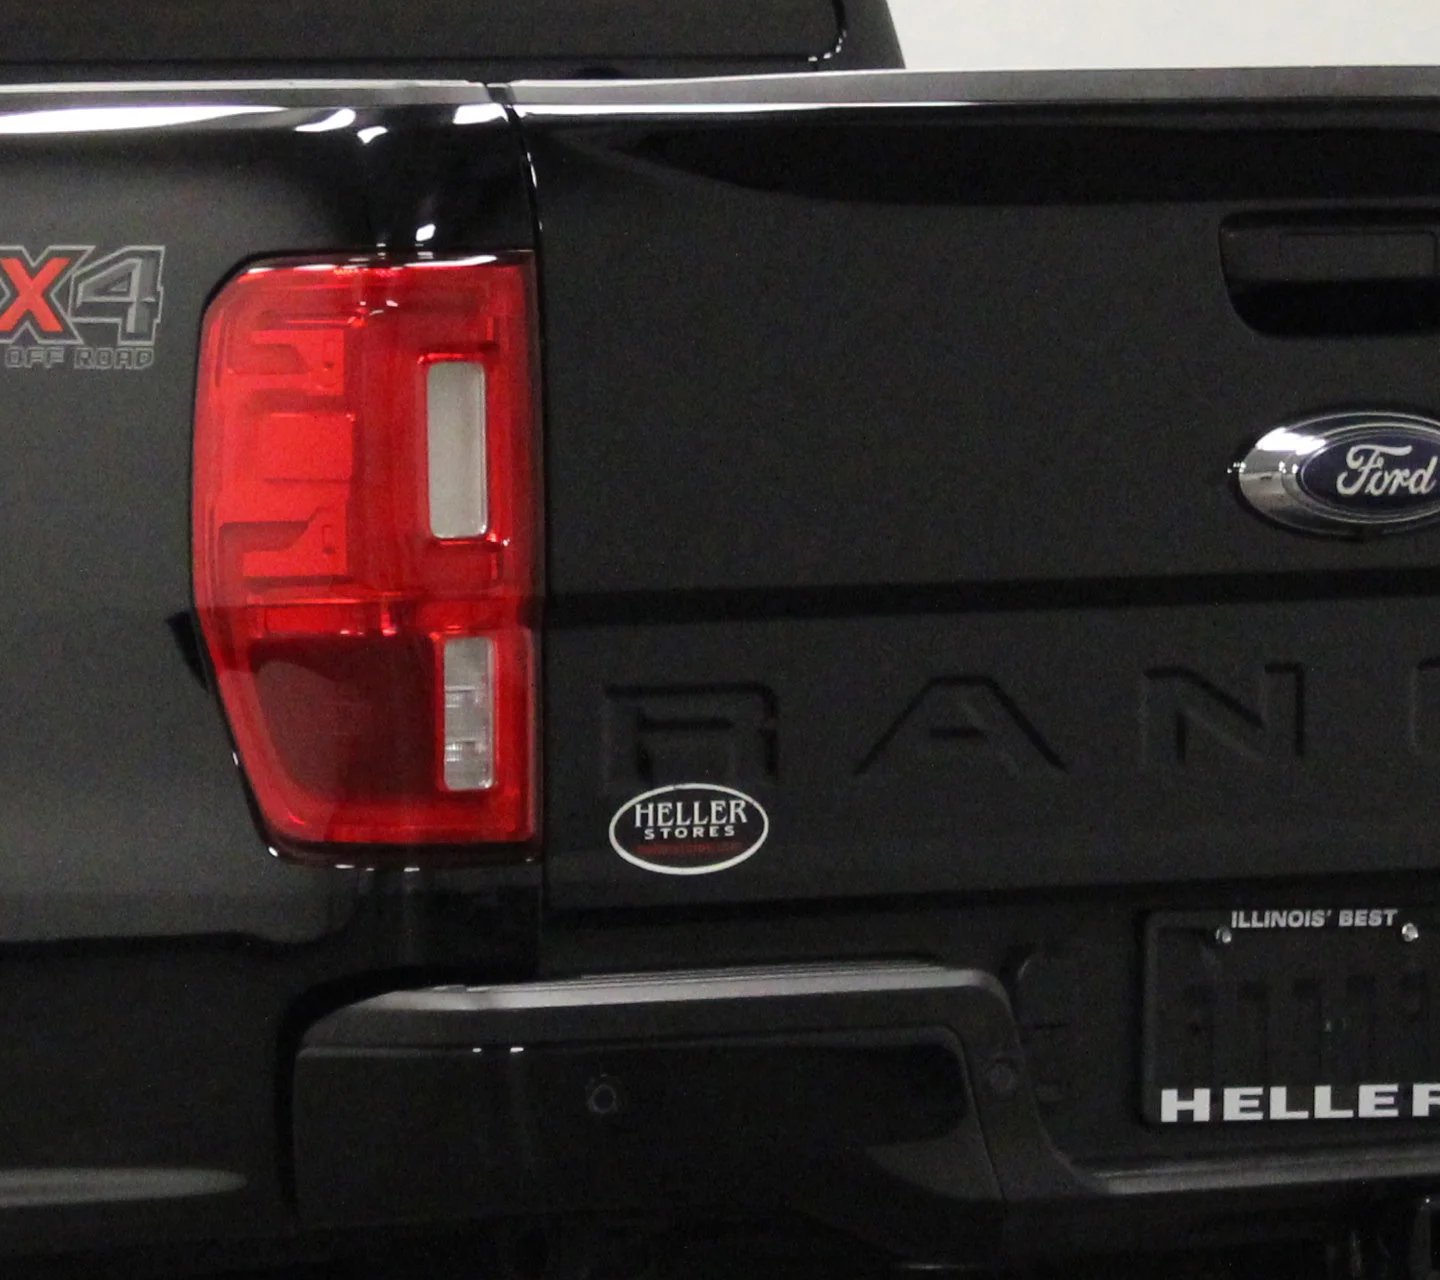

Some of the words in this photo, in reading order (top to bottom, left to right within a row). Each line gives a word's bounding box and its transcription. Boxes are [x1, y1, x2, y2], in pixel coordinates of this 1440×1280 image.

[5, 345, 64, 369] OFF
[73, 346, 155, 370] ROAD
[1335, 443, 1438, 497] Ford
[634, 799, 748, 829] HELLER
[644, 824, 736, 841] STORES
[1337, 908, 1399, 927] BEST
